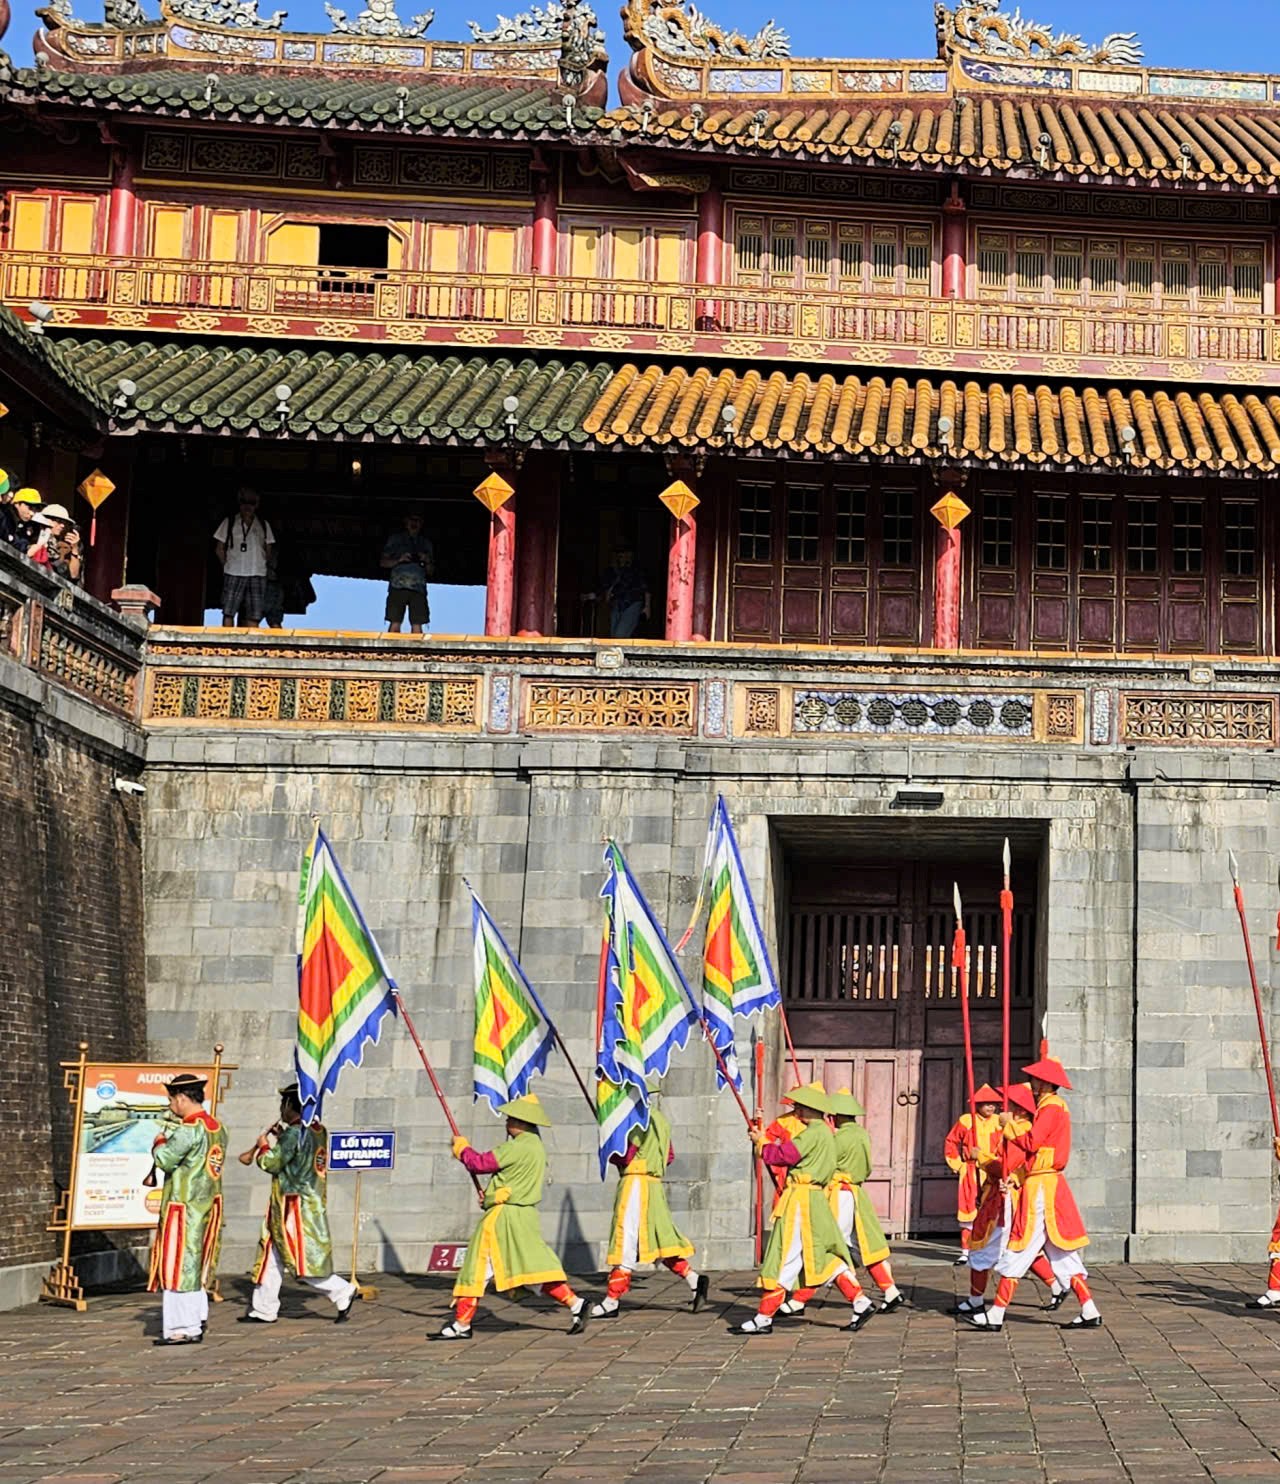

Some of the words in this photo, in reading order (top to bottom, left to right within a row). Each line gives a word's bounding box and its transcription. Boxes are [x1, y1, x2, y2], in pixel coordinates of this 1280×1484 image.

[340, 1135, 360, 1148] LỐI
[361, 1136, 384, 1148] VÀO
[332, 1149, 391, 1160] ENTRANCE
[440, 1248, 450, 1258] 7
